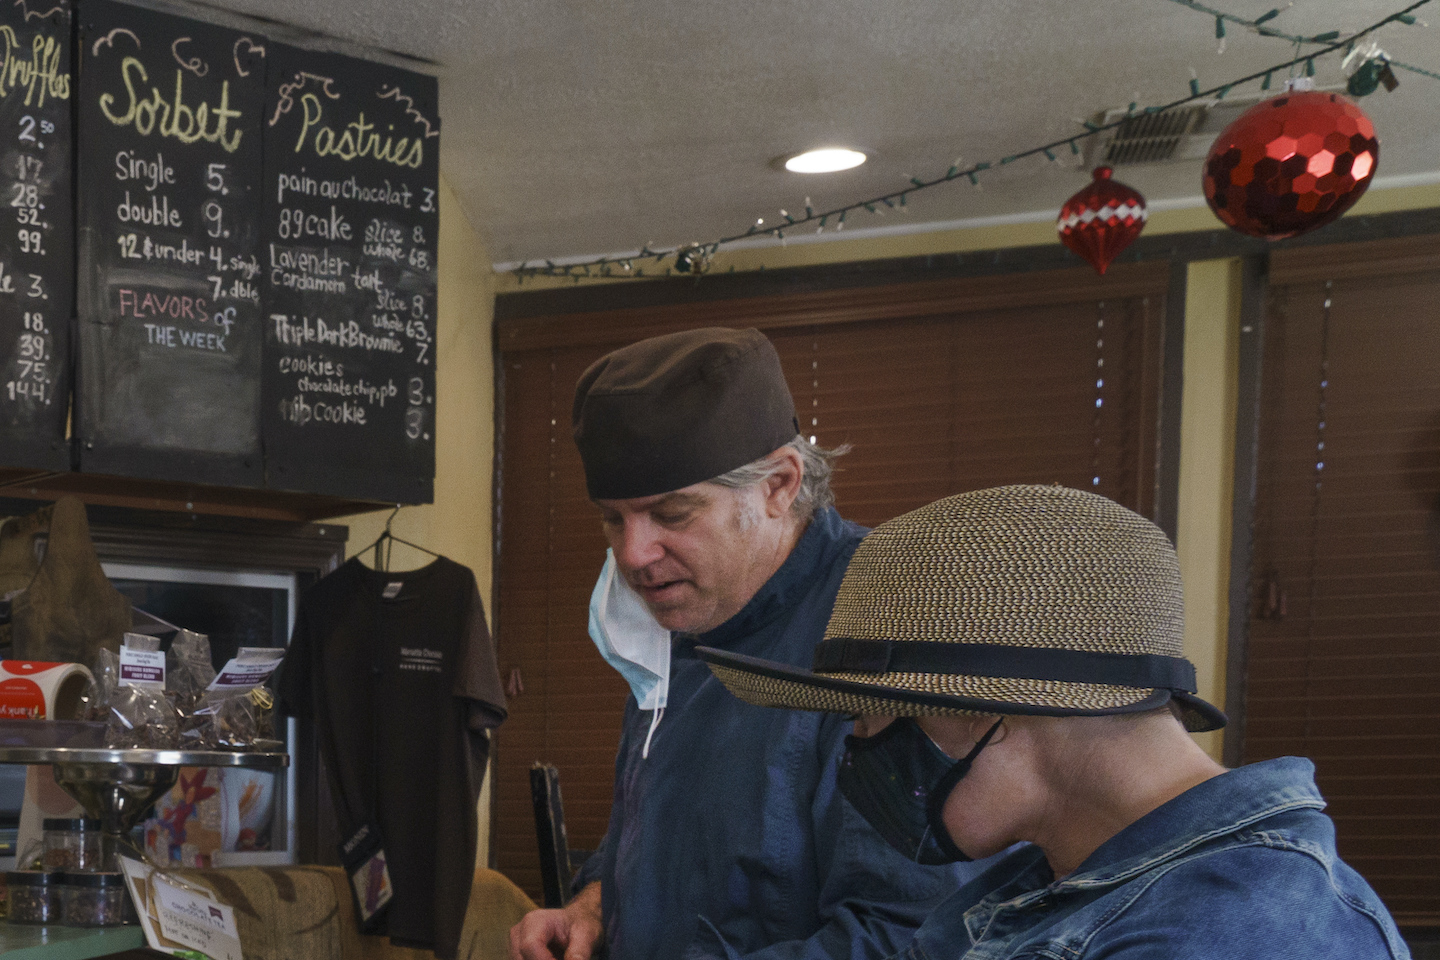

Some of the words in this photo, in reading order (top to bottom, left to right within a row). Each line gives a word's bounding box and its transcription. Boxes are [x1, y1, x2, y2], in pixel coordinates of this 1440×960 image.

[100, 56, 243, 153] Sorbet
[295, 93, 422, 168] Pastries
[115, 150, 176, 191] Single
[117, 191, 182, 227] double
[270, 244, 349, 276] Lavender
[120, 289, 208, 322] FLAVORS
[144, 324, 177, 347] THE
[179, 329, 226, 351] WEEK
